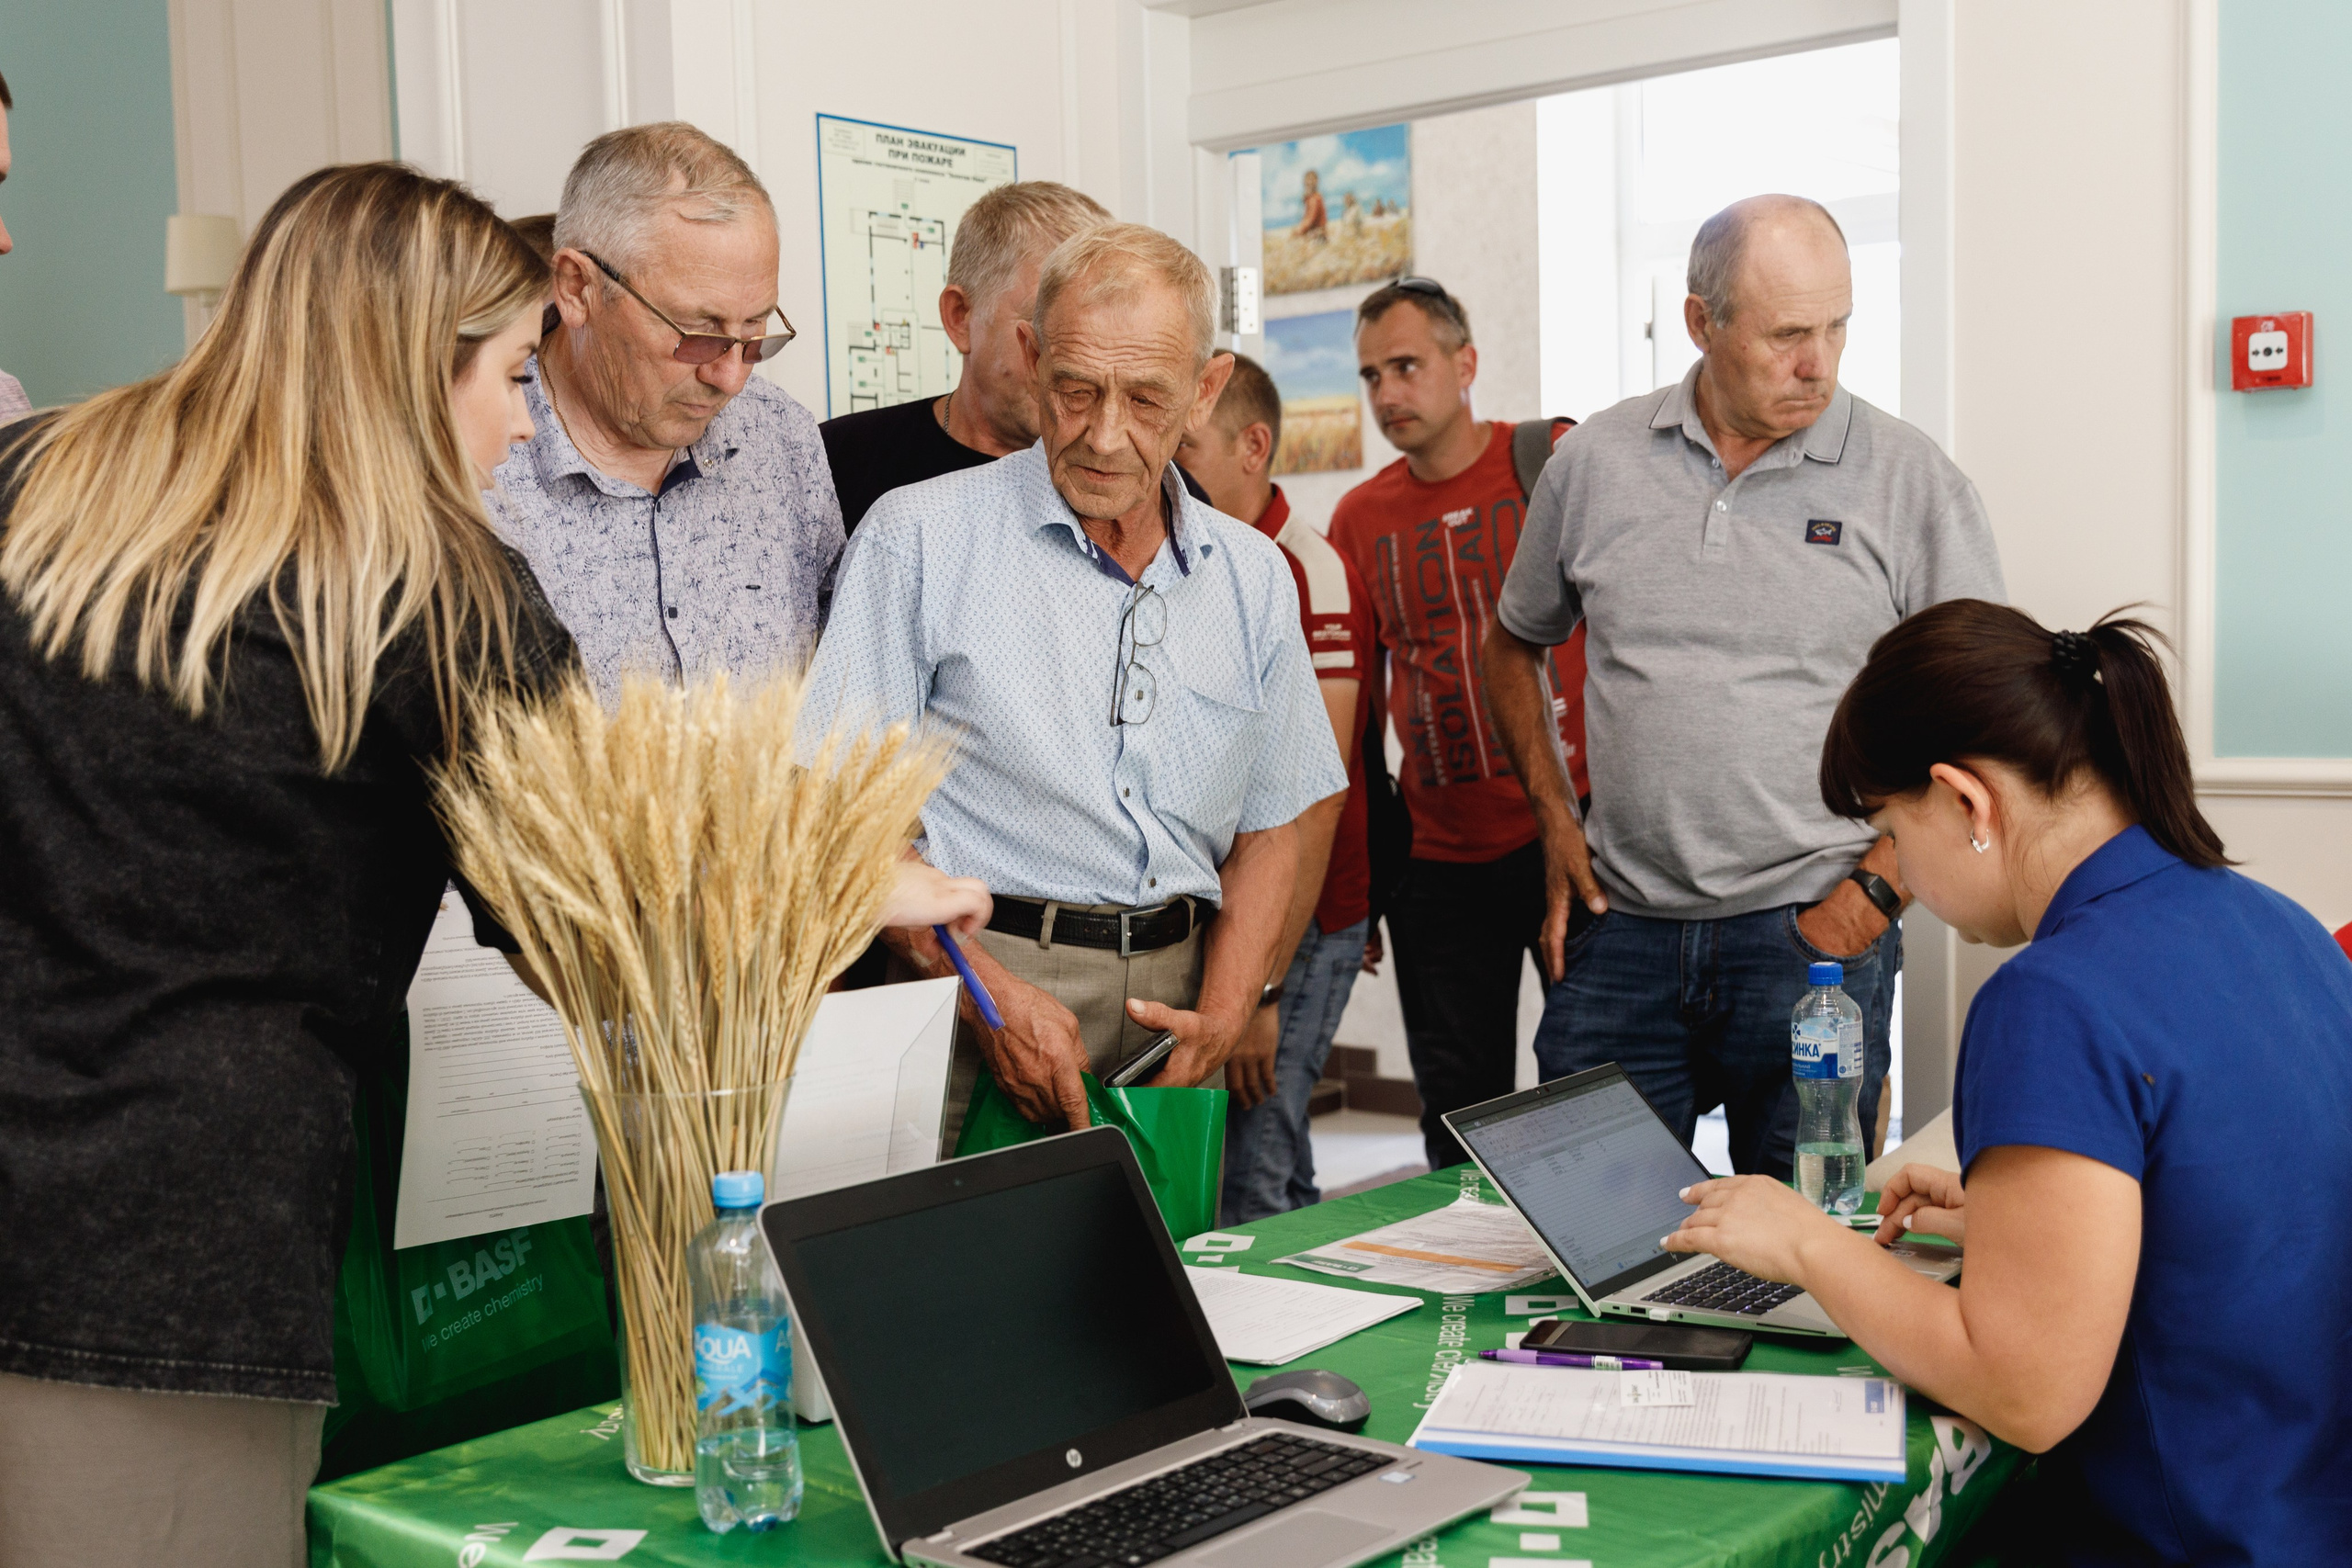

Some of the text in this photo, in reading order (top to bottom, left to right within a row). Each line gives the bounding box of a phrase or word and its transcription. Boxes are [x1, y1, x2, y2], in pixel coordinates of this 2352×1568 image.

[876, 133, 904, 148] ПЛАН
[908, 140, 967, 156] ЭВАКУАЦИИ
[888, 149, 954, 168] ПРИ ПОЖАРЕ
[1415, 518, 1479, 783] ISOLATION
[447, 1226, 533, 1302] BASF
[440, 1310, 482, 1340] create
[484, 1274, 543, 1316] chemistry
[1442, 1294, 1475, 1313] We
[1437, 1313, 1472, 1348] create
[1865, 1415, 1992, 1568] BAS
[458, 1521, 520, 1568] We
